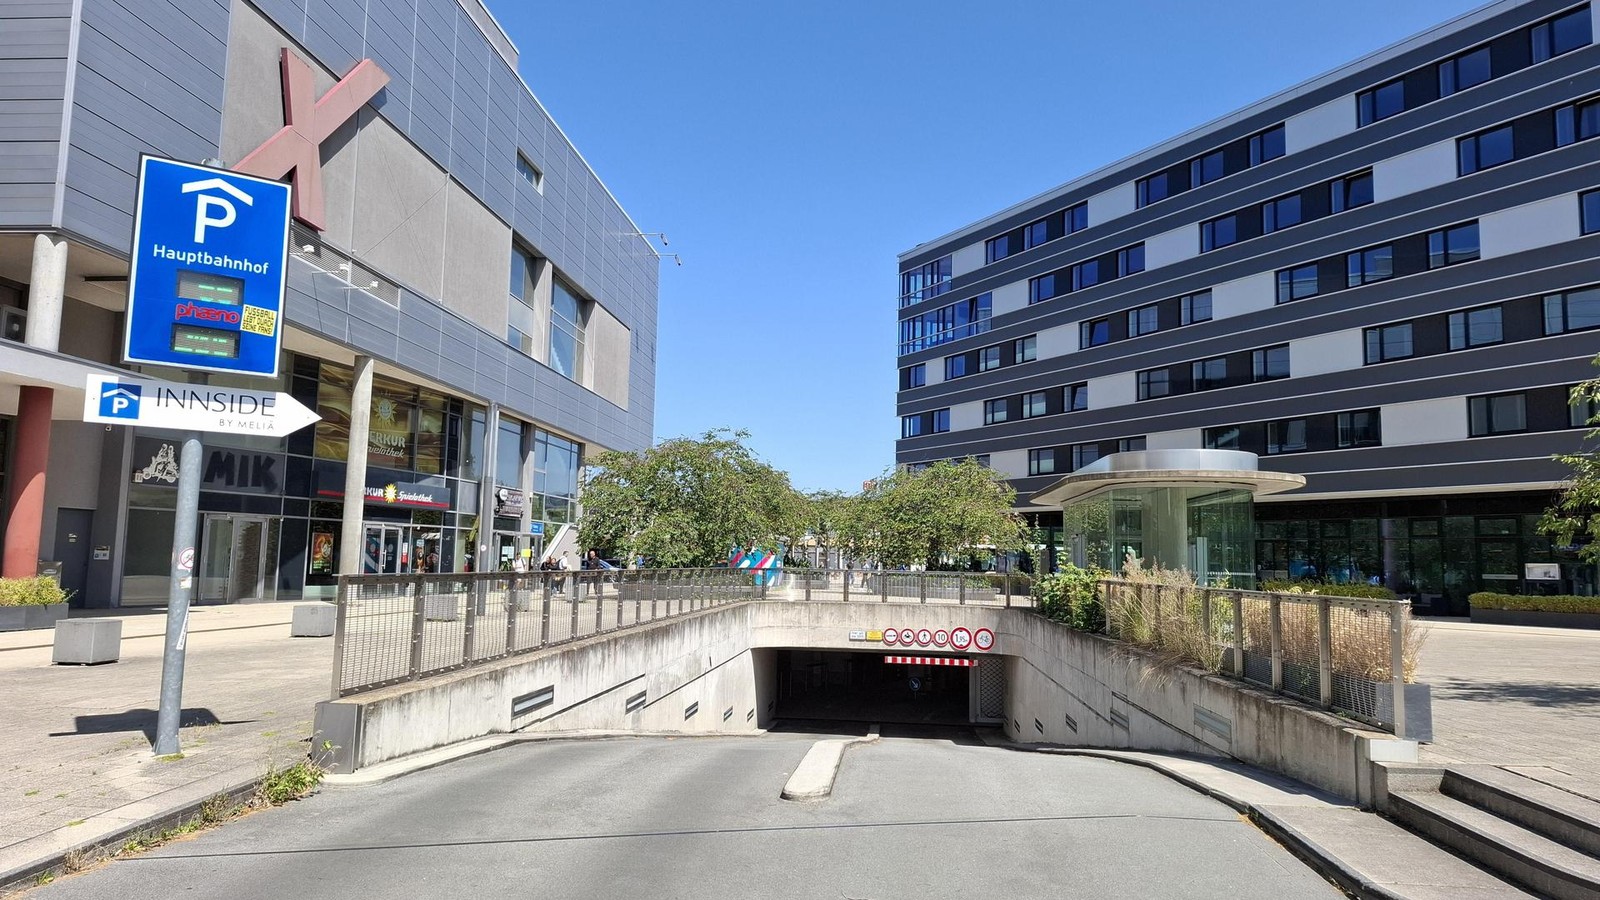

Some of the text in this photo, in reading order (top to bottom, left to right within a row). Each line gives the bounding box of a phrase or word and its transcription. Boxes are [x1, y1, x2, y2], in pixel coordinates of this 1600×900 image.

[194, 193, 237, 244] P
[153, 244, 269, 275] Hauptbahnhof
[245, 306, 274, 320] FUSSBALL
[242, 322, 257, 332] SEINE
[243, 315, 273, 327] LEBT DURCH
[112, 387, 276, 417] P INNSIDE
[219, 418, 234, 427] BY
[368, 431, 405, 448] ERKUR
[203, 450, 278, 493] MIK
[364, 487, 433, 502] KUR Spielothek
[937, 633, 946, 642] 10
